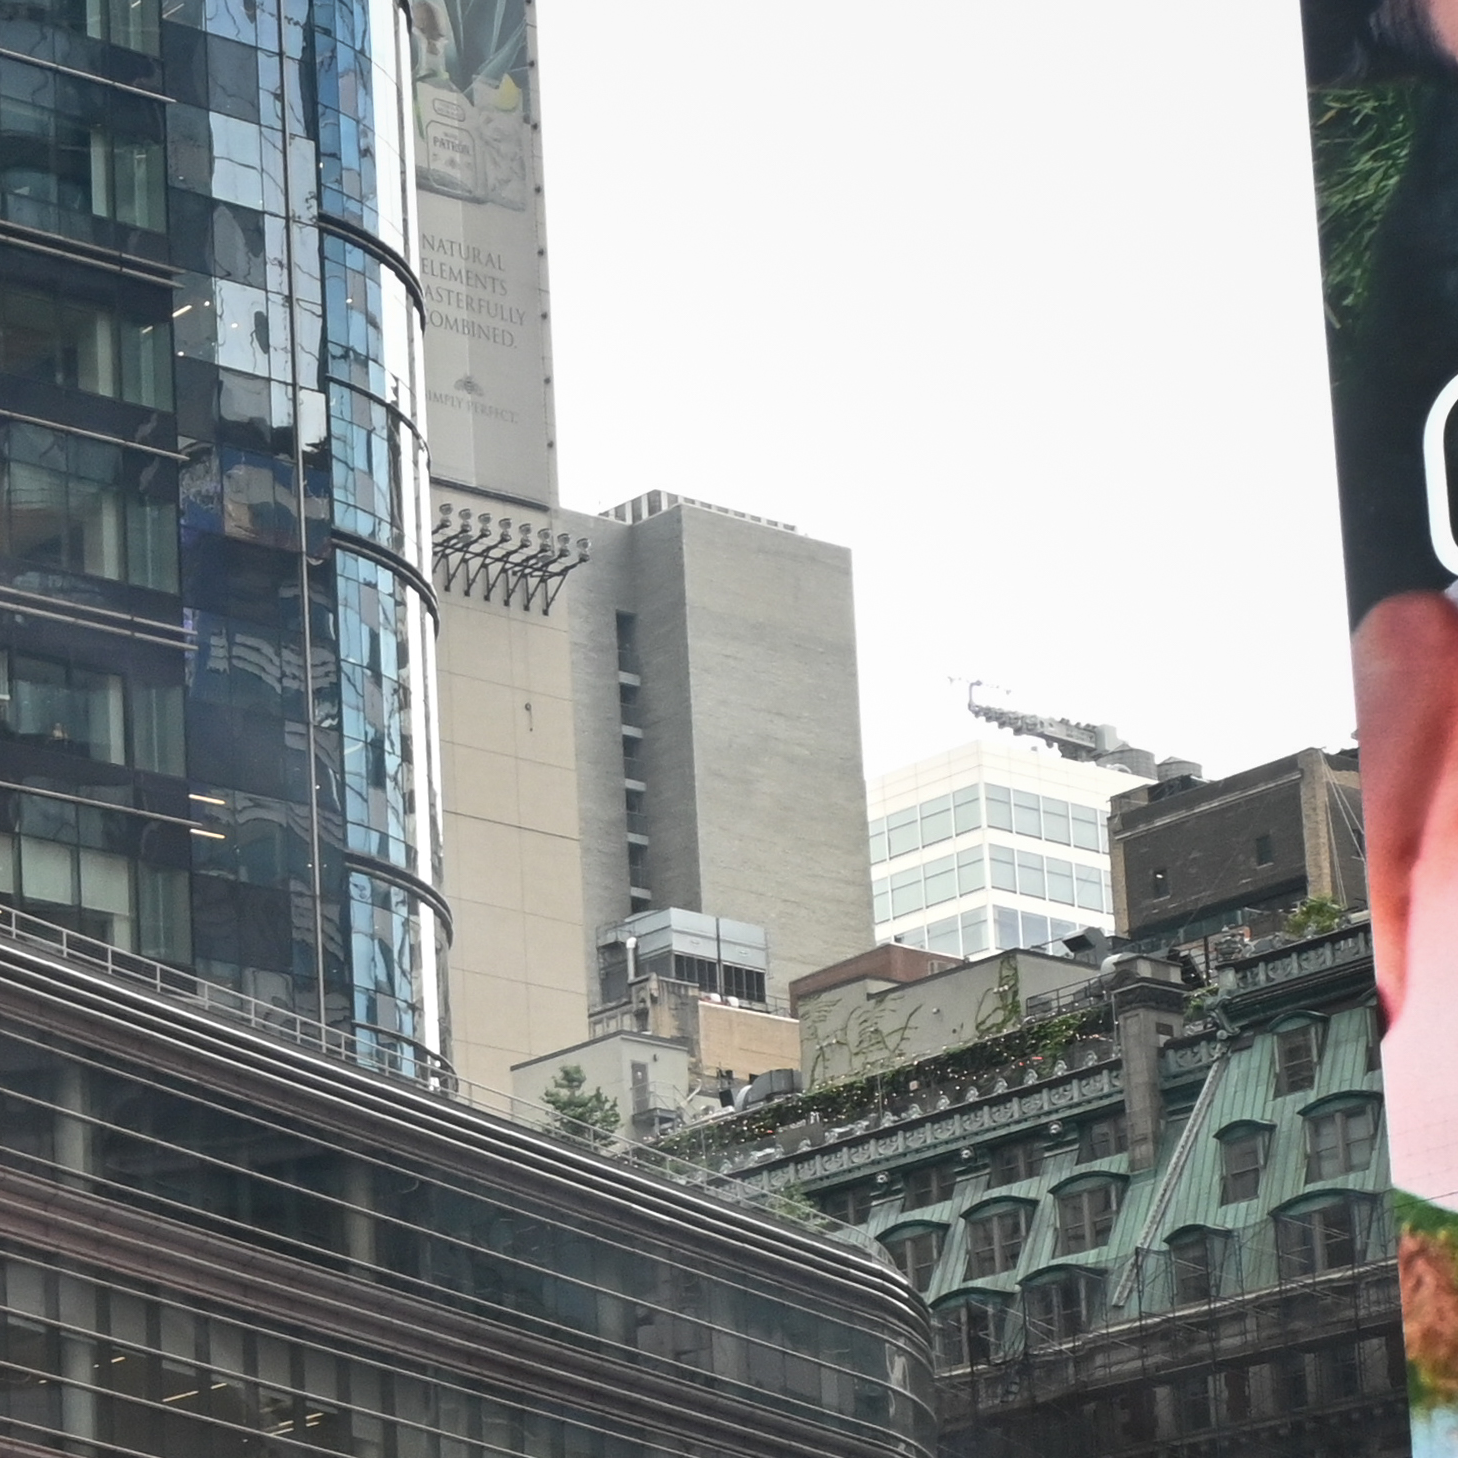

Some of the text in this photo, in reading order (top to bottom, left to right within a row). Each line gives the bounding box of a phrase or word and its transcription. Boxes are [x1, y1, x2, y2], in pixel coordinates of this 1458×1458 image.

[422, 233, 505, 272] NATURAL
[421, 257, 508, 297] ELEMENTS
[425, 283, 526, 326] ASTERFULLY
